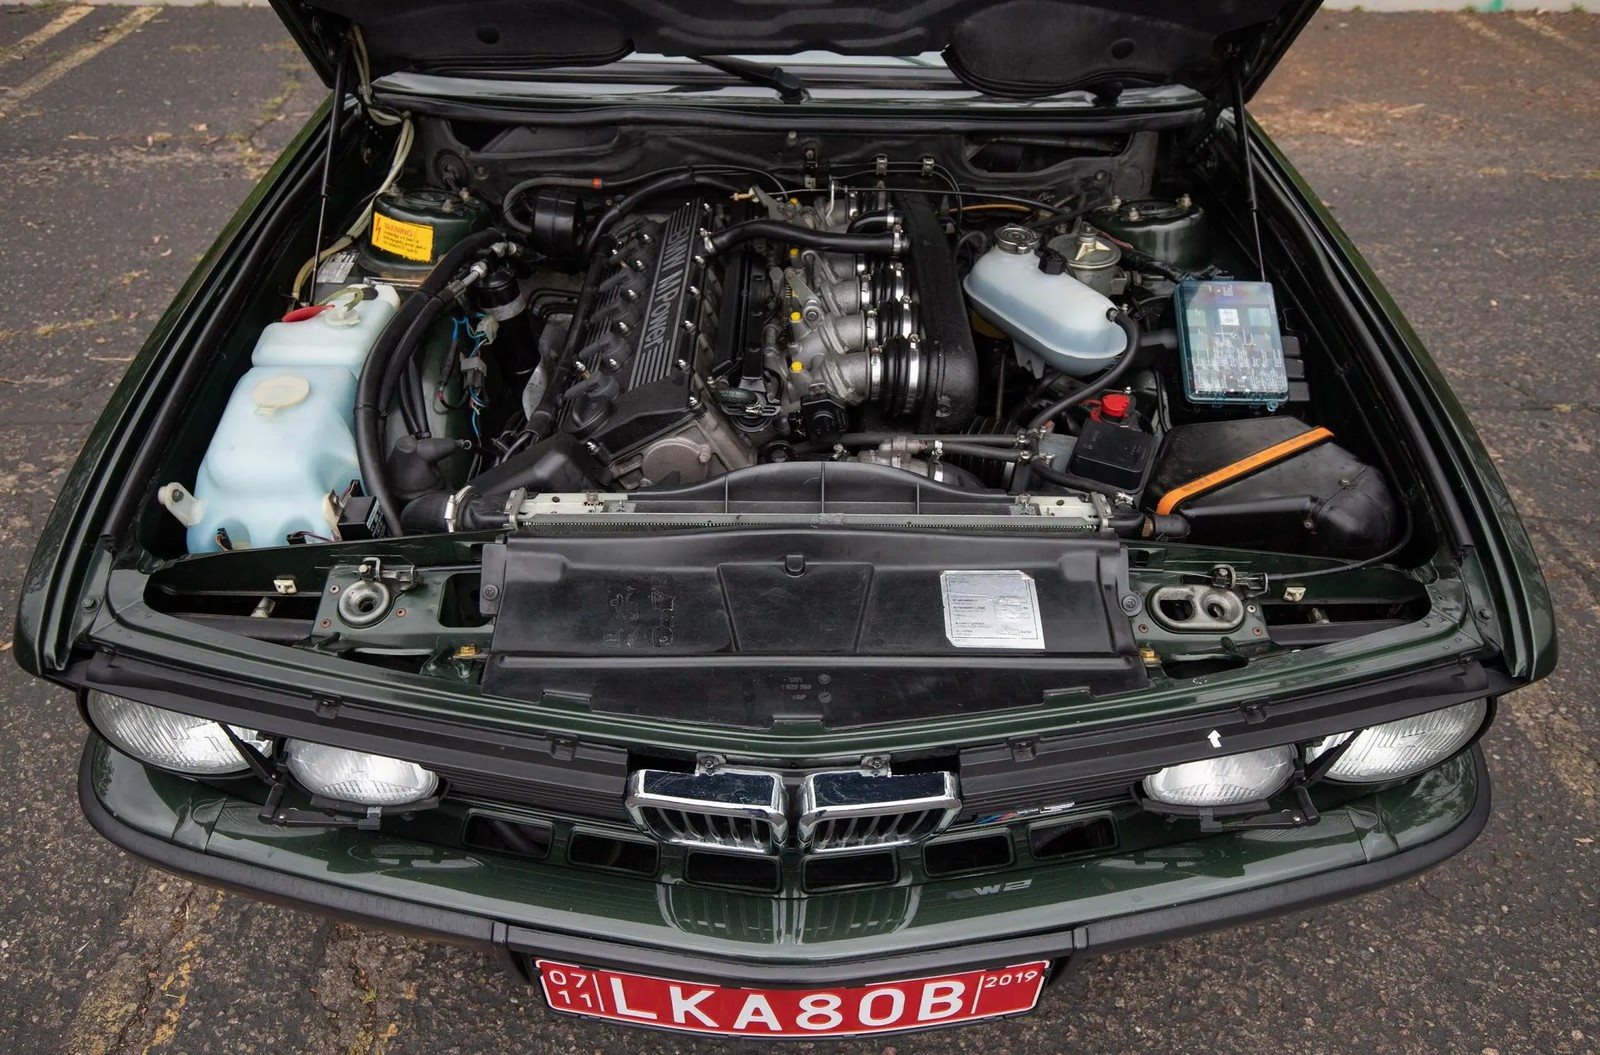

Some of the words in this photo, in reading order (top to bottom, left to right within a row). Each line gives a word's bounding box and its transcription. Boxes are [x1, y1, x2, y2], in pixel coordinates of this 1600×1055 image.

[661, 225, 691, 272] BMW
[549, 969, 587, 989] 07
[984, 970, 1039, 989] 2019
[557, 990, 593, 1008] 11
